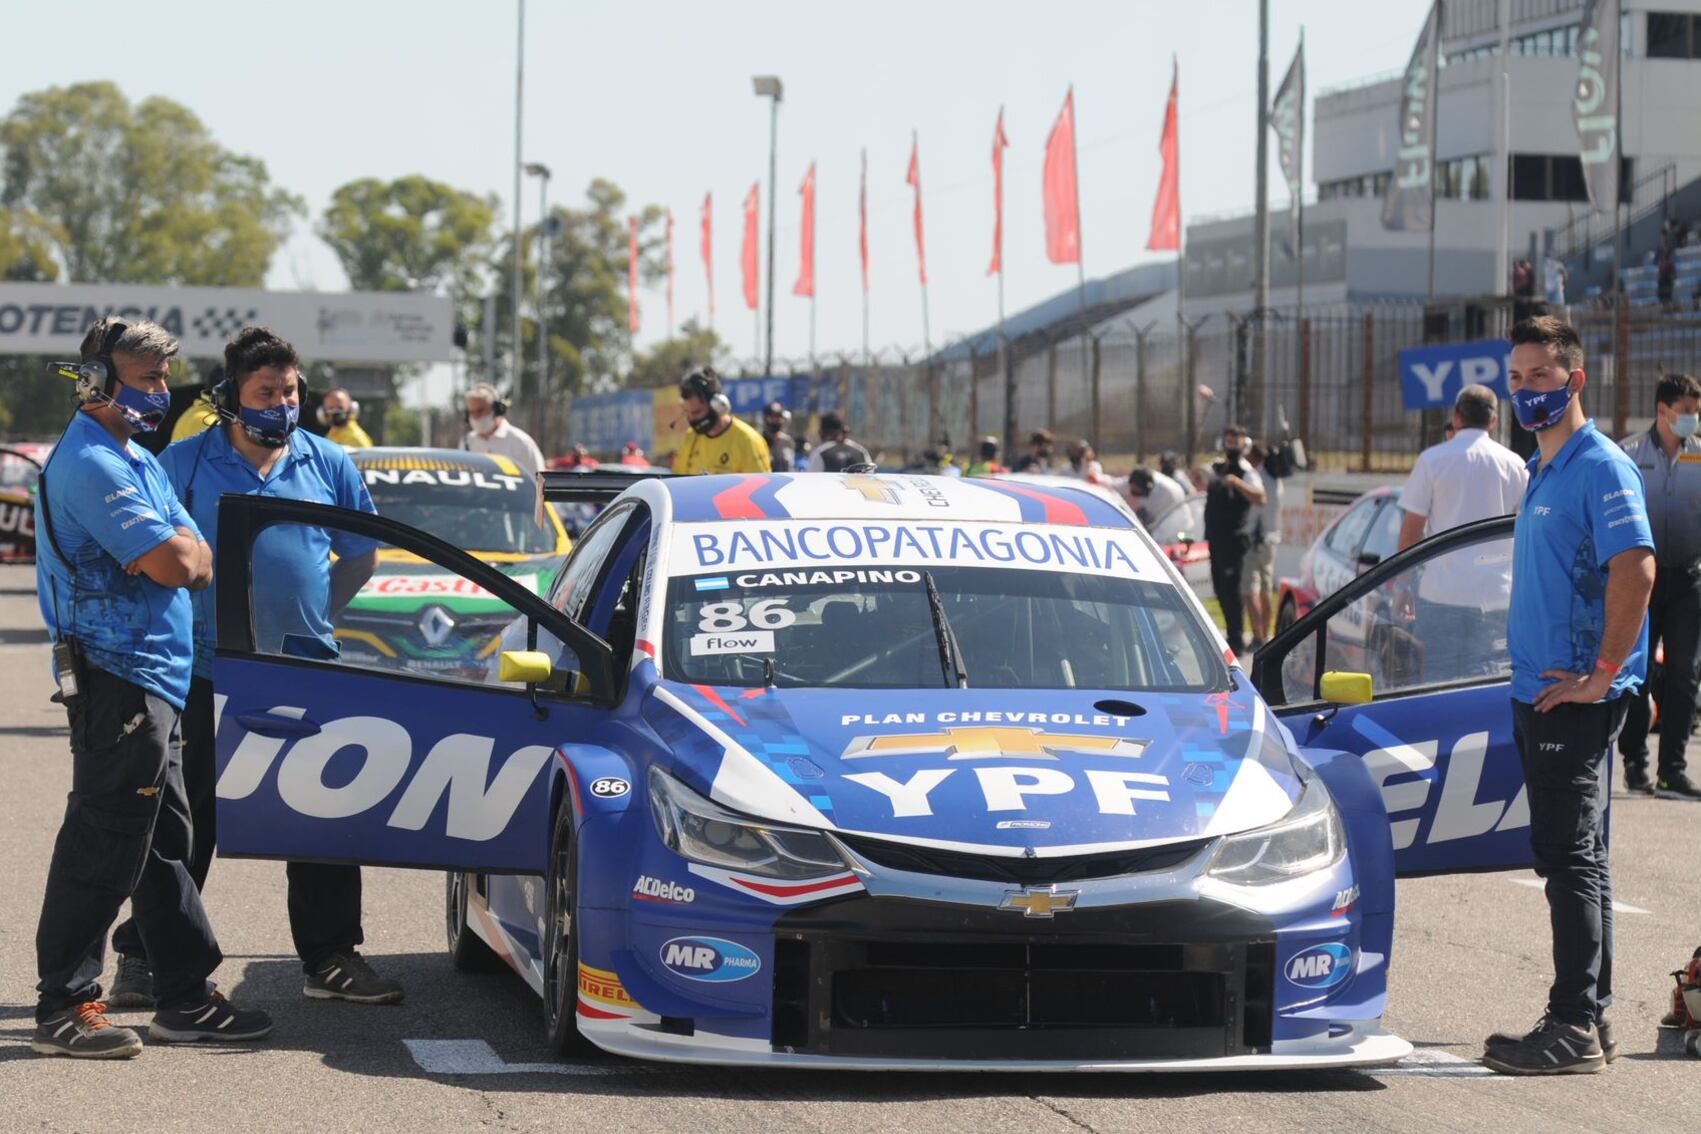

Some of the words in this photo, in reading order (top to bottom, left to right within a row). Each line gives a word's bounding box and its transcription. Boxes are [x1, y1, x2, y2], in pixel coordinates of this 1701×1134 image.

[1410, 353, 1511, 401] YP
[1525, 394, 1548, 407] YPF
[693, 526, 1140, 573] BANCOPATAGONIA
[736, 570, 921, 588] CANAPINO
[698, 599, 796, 633] 86
[707, 638, 757, 649] flow
[842, 712, 925, 725] PLAN
[937, 711, 1131, 727] CHEVROLET
[1538, 743, 1566, 751] YPF
[214, 694, 554, 842] ION
[594, 780, 625, 794] 86
[840, 766, 1171, 818] YPF
[633, 874, 695, 903] ACDelco
[665, 944, 716, 970] MR
[723, 956, 757, 969] PHARMA
[1290, 954, 1331, 979] MR
